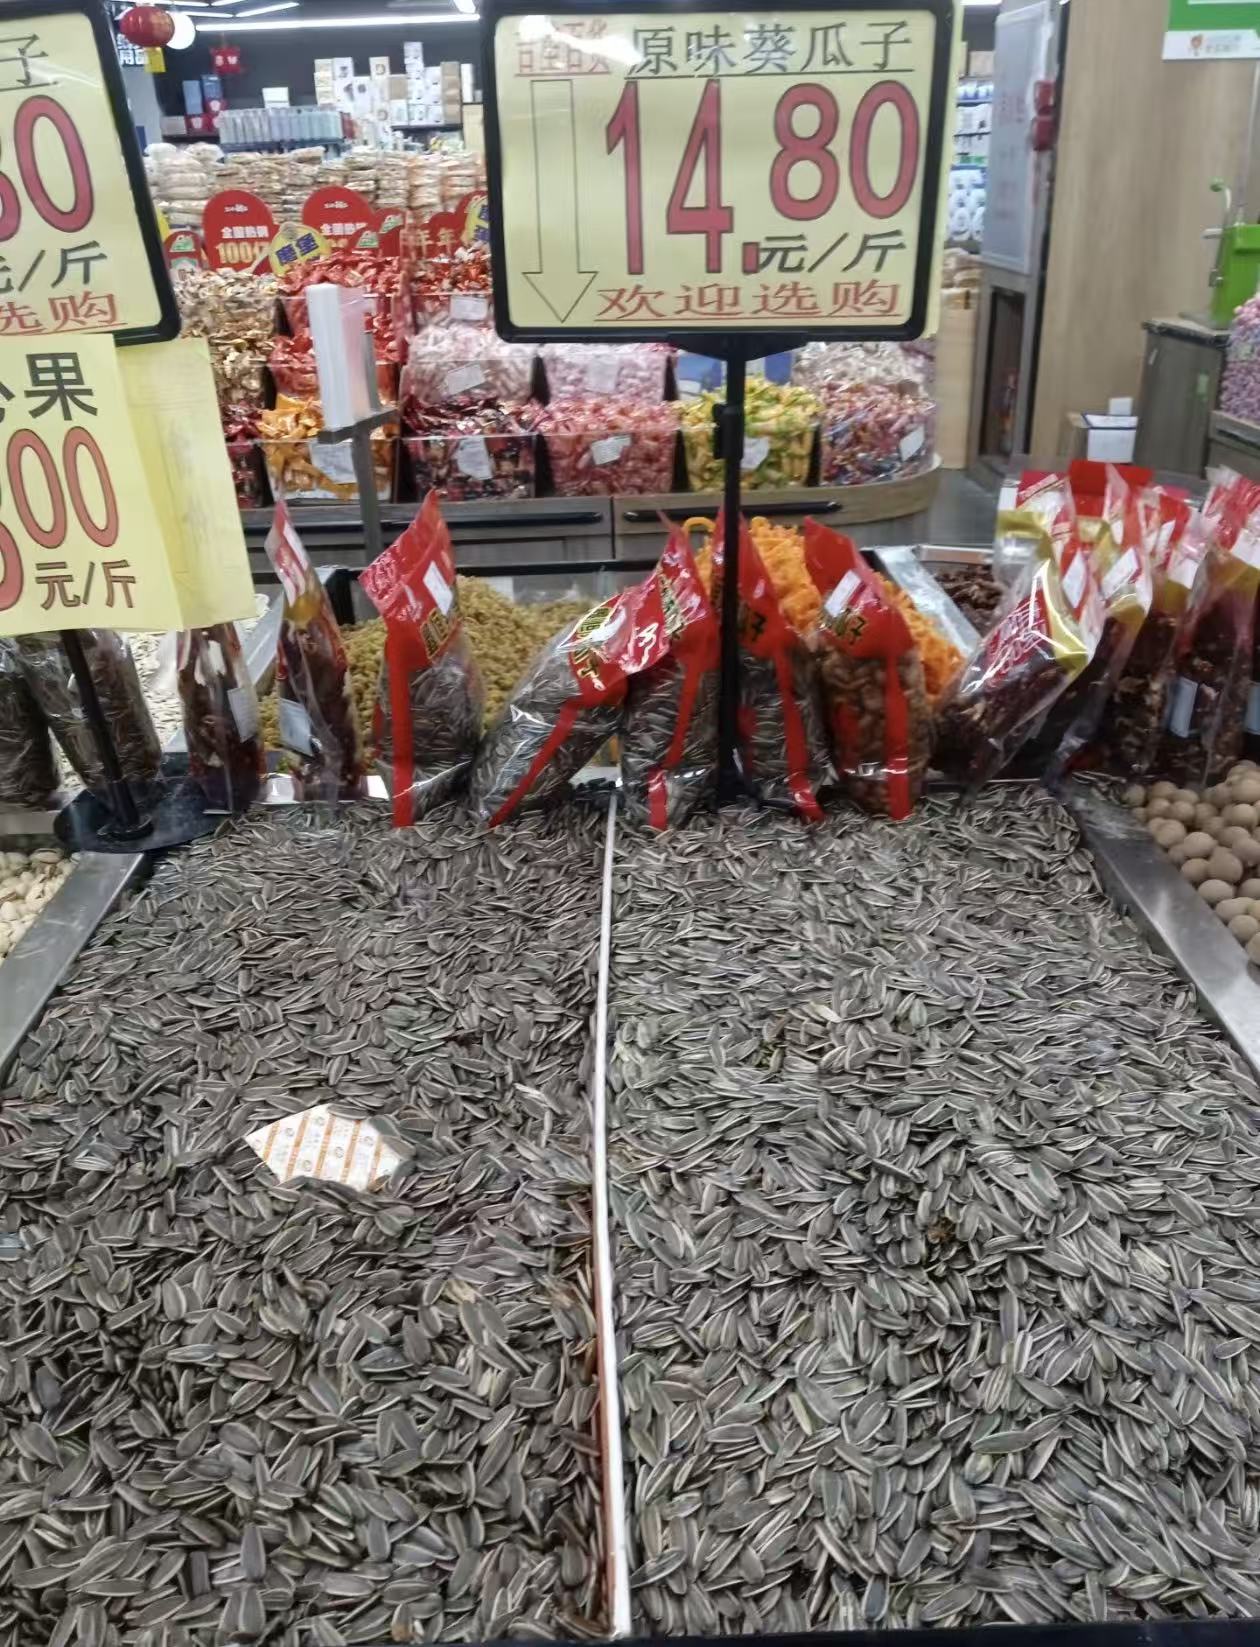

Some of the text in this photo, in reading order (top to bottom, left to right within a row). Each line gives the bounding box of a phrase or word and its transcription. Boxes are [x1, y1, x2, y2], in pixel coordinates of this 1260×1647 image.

[626, 21, 912, 75] 原味葵瓜子
[0, 94, 94, 242] 0
[606, 78, 920, 275] 14.80
[758, 229, 908, 274] 元/斤
[597, 279, 902, 319] 欢迎选购
[0, 352, 98, 423] 果
[35, 559, 136, 610] 元/斤
